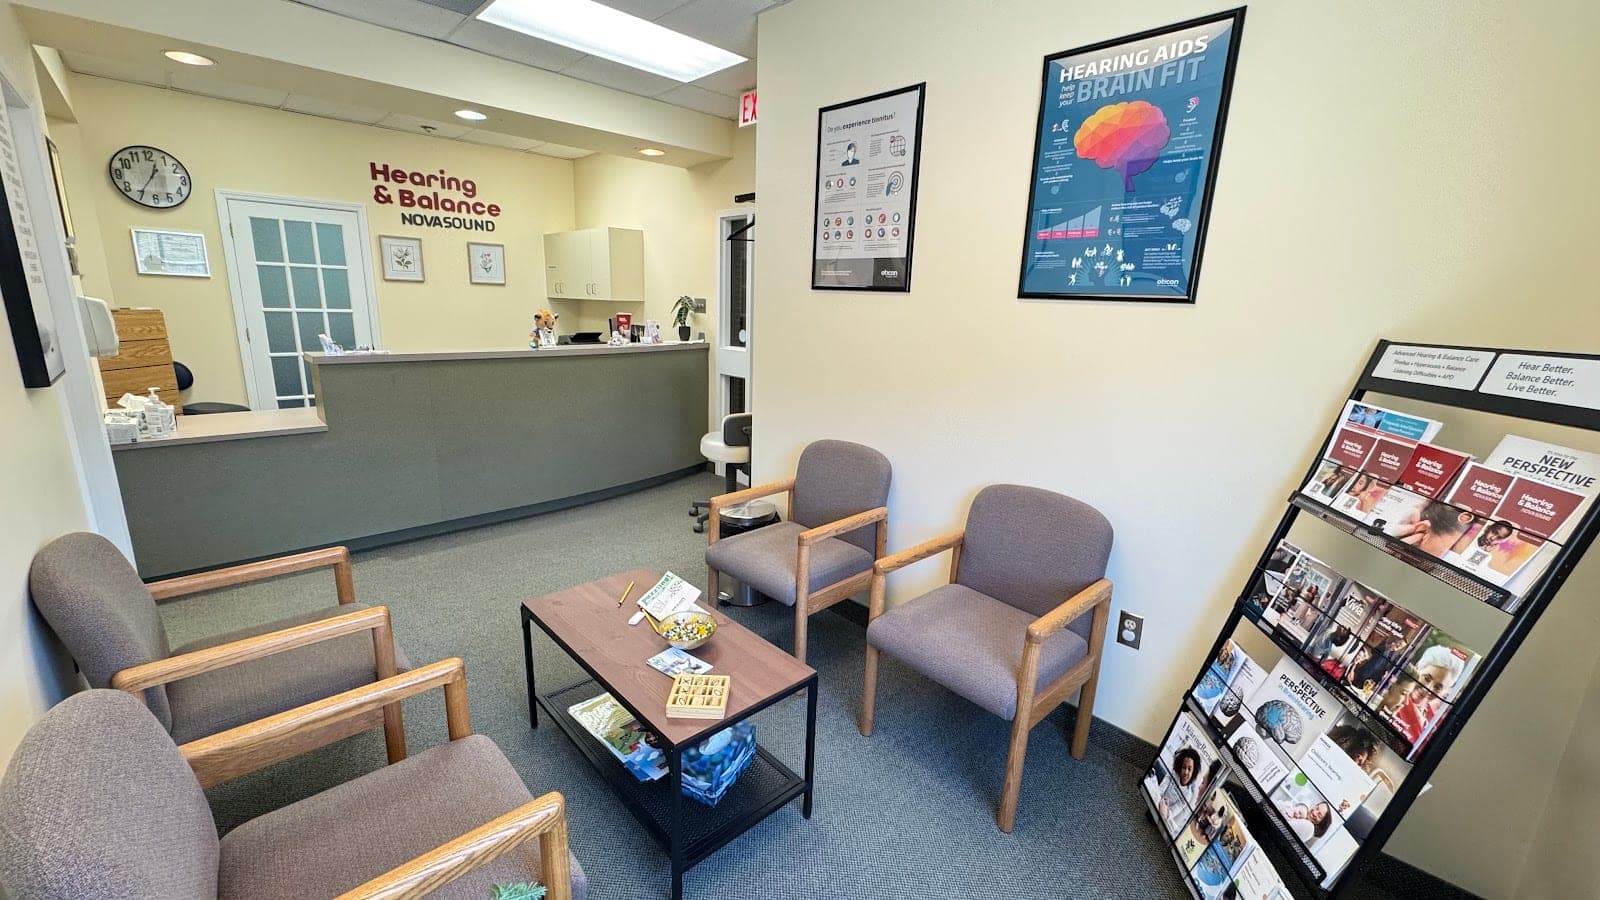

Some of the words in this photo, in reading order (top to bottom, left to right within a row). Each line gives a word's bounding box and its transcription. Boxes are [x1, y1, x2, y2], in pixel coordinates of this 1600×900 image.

[1060, 50, 1149, 83] HEARING
[1154, 35, 1209, 63] AIDS
[1077, 68, 1155, 103] BRAIN
[1160, 56, 1206, 87] FIT
[1062, 83, 1076, 93] help
[1060, 90, 1075, 100] keep
[742, 94, 757, 123] EX
[1058, 98, 1073, 109] your
[842, 120, 871, 130] experience
[871, 112, 896, 124] tinnitus?
[128, 151, 140, 163] 11
[142, 150, 154, 162] 12
[161, 155, 167, 167] 1
[118, 157, 131, 170] 10
[171, 163, 180, 174] 2
[114, 168, 123, 180] 9
[370, 162, 477, 198] Hearing
[123, 181, 132, 193] 8
[180, 175, 187, 187] 3
[137, 189, 145, 200] 7
[166, 192, 174, 203] 5
[176, 186, 183, 197] 4
[152, 193, 160, 205] 6
[373, 185, 394, 204] &
[398, 189, 501, 217] Balance
[401, 212, 496, 232] NOVASOUND
[1417, 352, 1437, 360] Hearing
[1442, 354, 1465, 362] Balance
[1465, 355, 1480, 363] Care
[1518, 362, 1541, 371] Hear
[1541, 363, 1574, 374] Better.
[1506, 371, 1541, 383] Balance
[1542, 375, 1575, 387] Better.
[1507, 382, 1526, 392] Live
[1526, 385, 1557, 397] Better.
[1419, 456, 1443, 469] Hearing
[1539, 455, 1575, 470] NEW
[1421, 463, 1444, 476] Balance
[1503, 456, 1596, 488] PERSPECTIVE
[1474, 479, 1502, 493] Hearing
[1476, 487, 1503, 499] Balance
[1521, 493, 1554, 509] Hearing
[1524, 502, 1556, 516] Balance
[1299, 679, 1318, 698] NEW
[1280, 673, 1326, 718] PERSPECTIVE
[1182, 721, 1213, 764] HearingRevie
